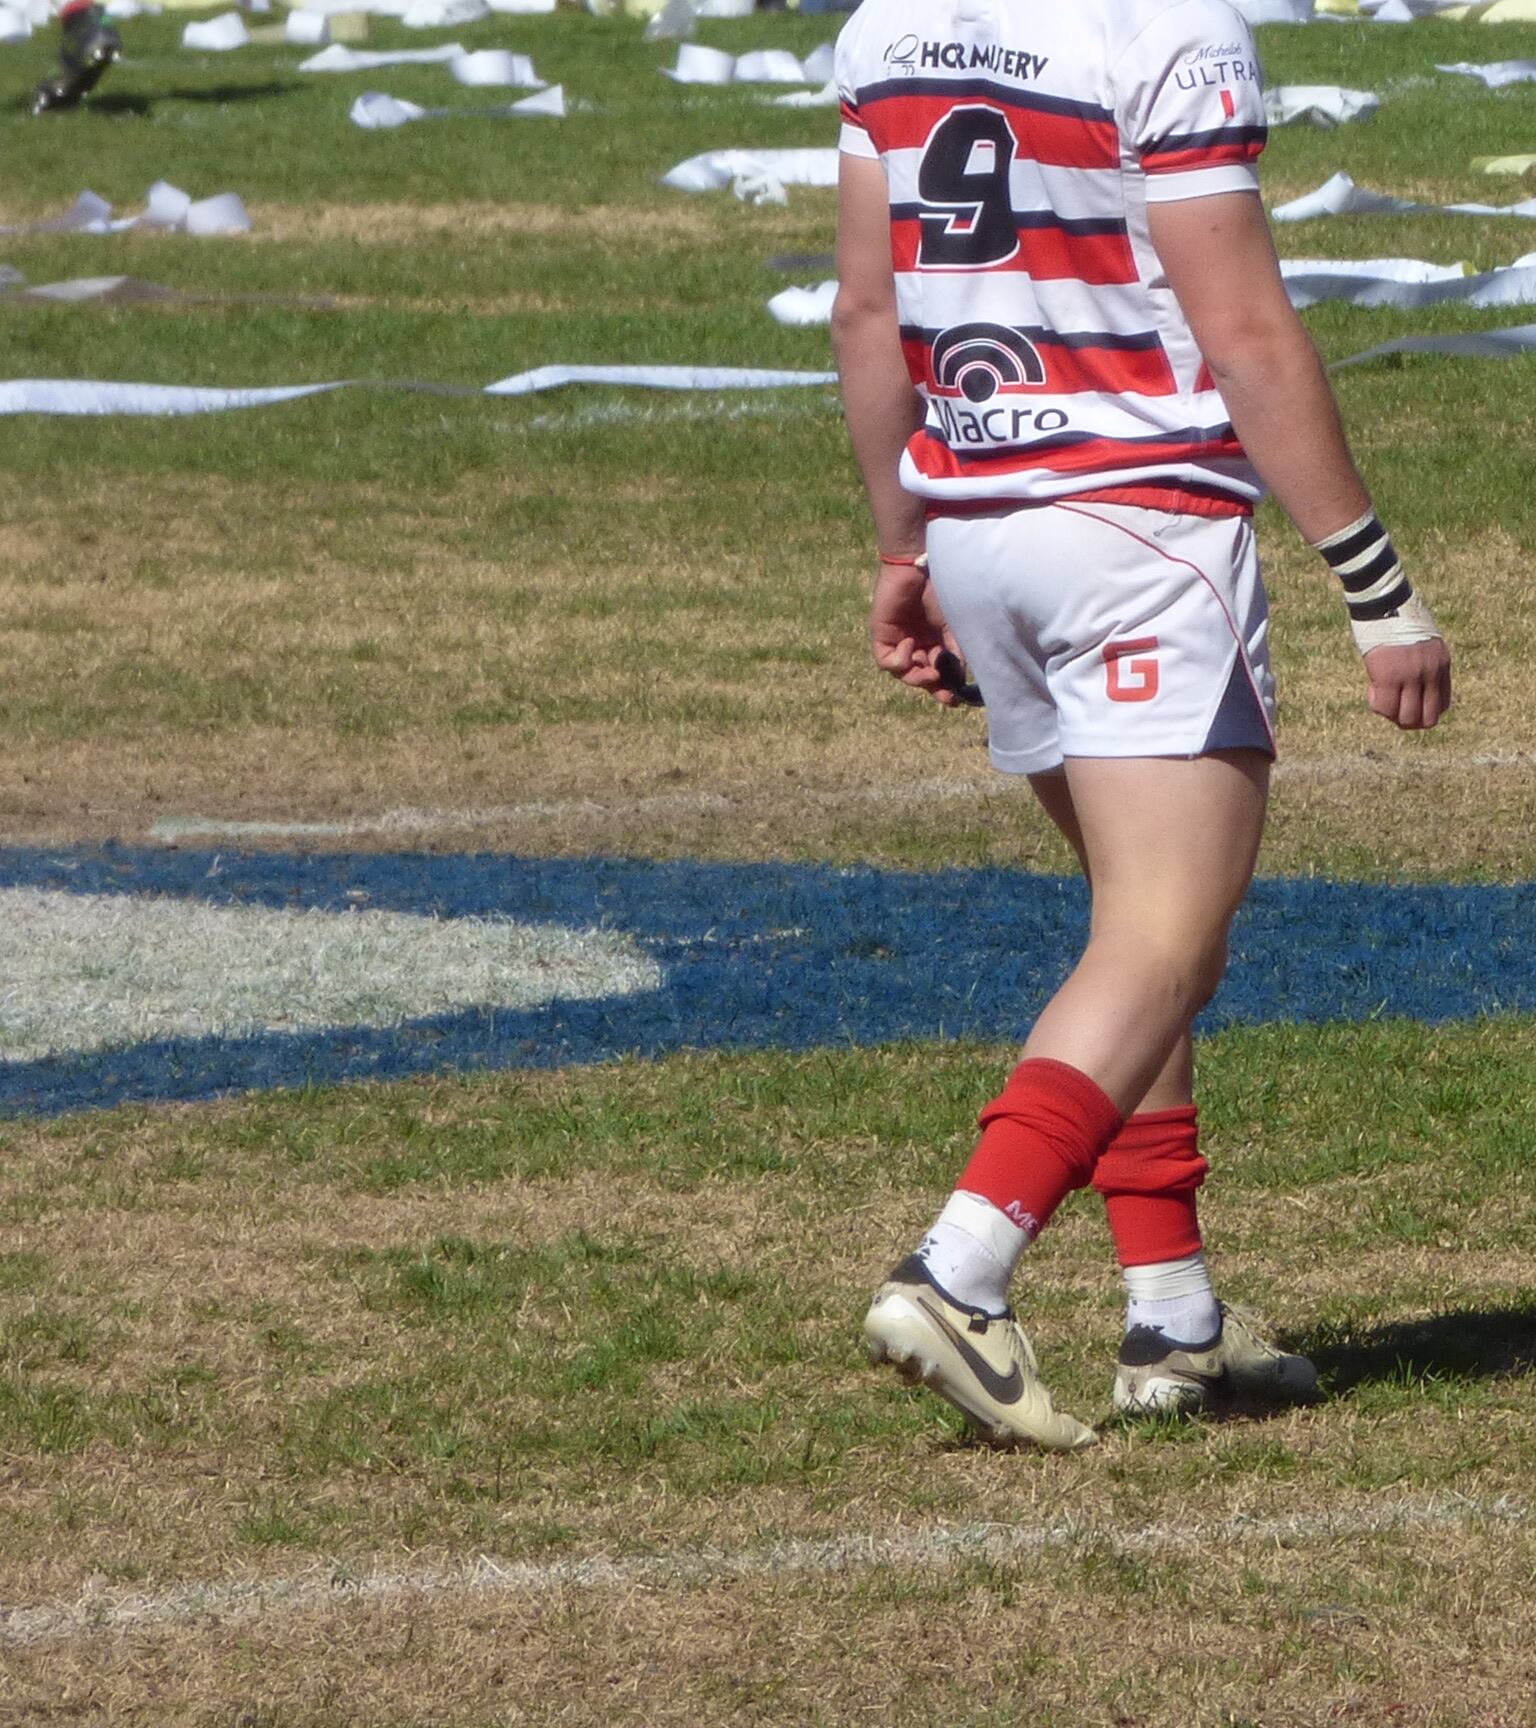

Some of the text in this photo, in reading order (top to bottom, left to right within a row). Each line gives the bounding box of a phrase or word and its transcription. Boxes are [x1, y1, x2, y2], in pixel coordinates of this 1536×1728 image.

[1174, 60, 1257, 91] ULTRA
[917, 104, 1020, 270] 9
[930, 397, 1070, 445] Macro
[1101, 635, 1159, 703] G
